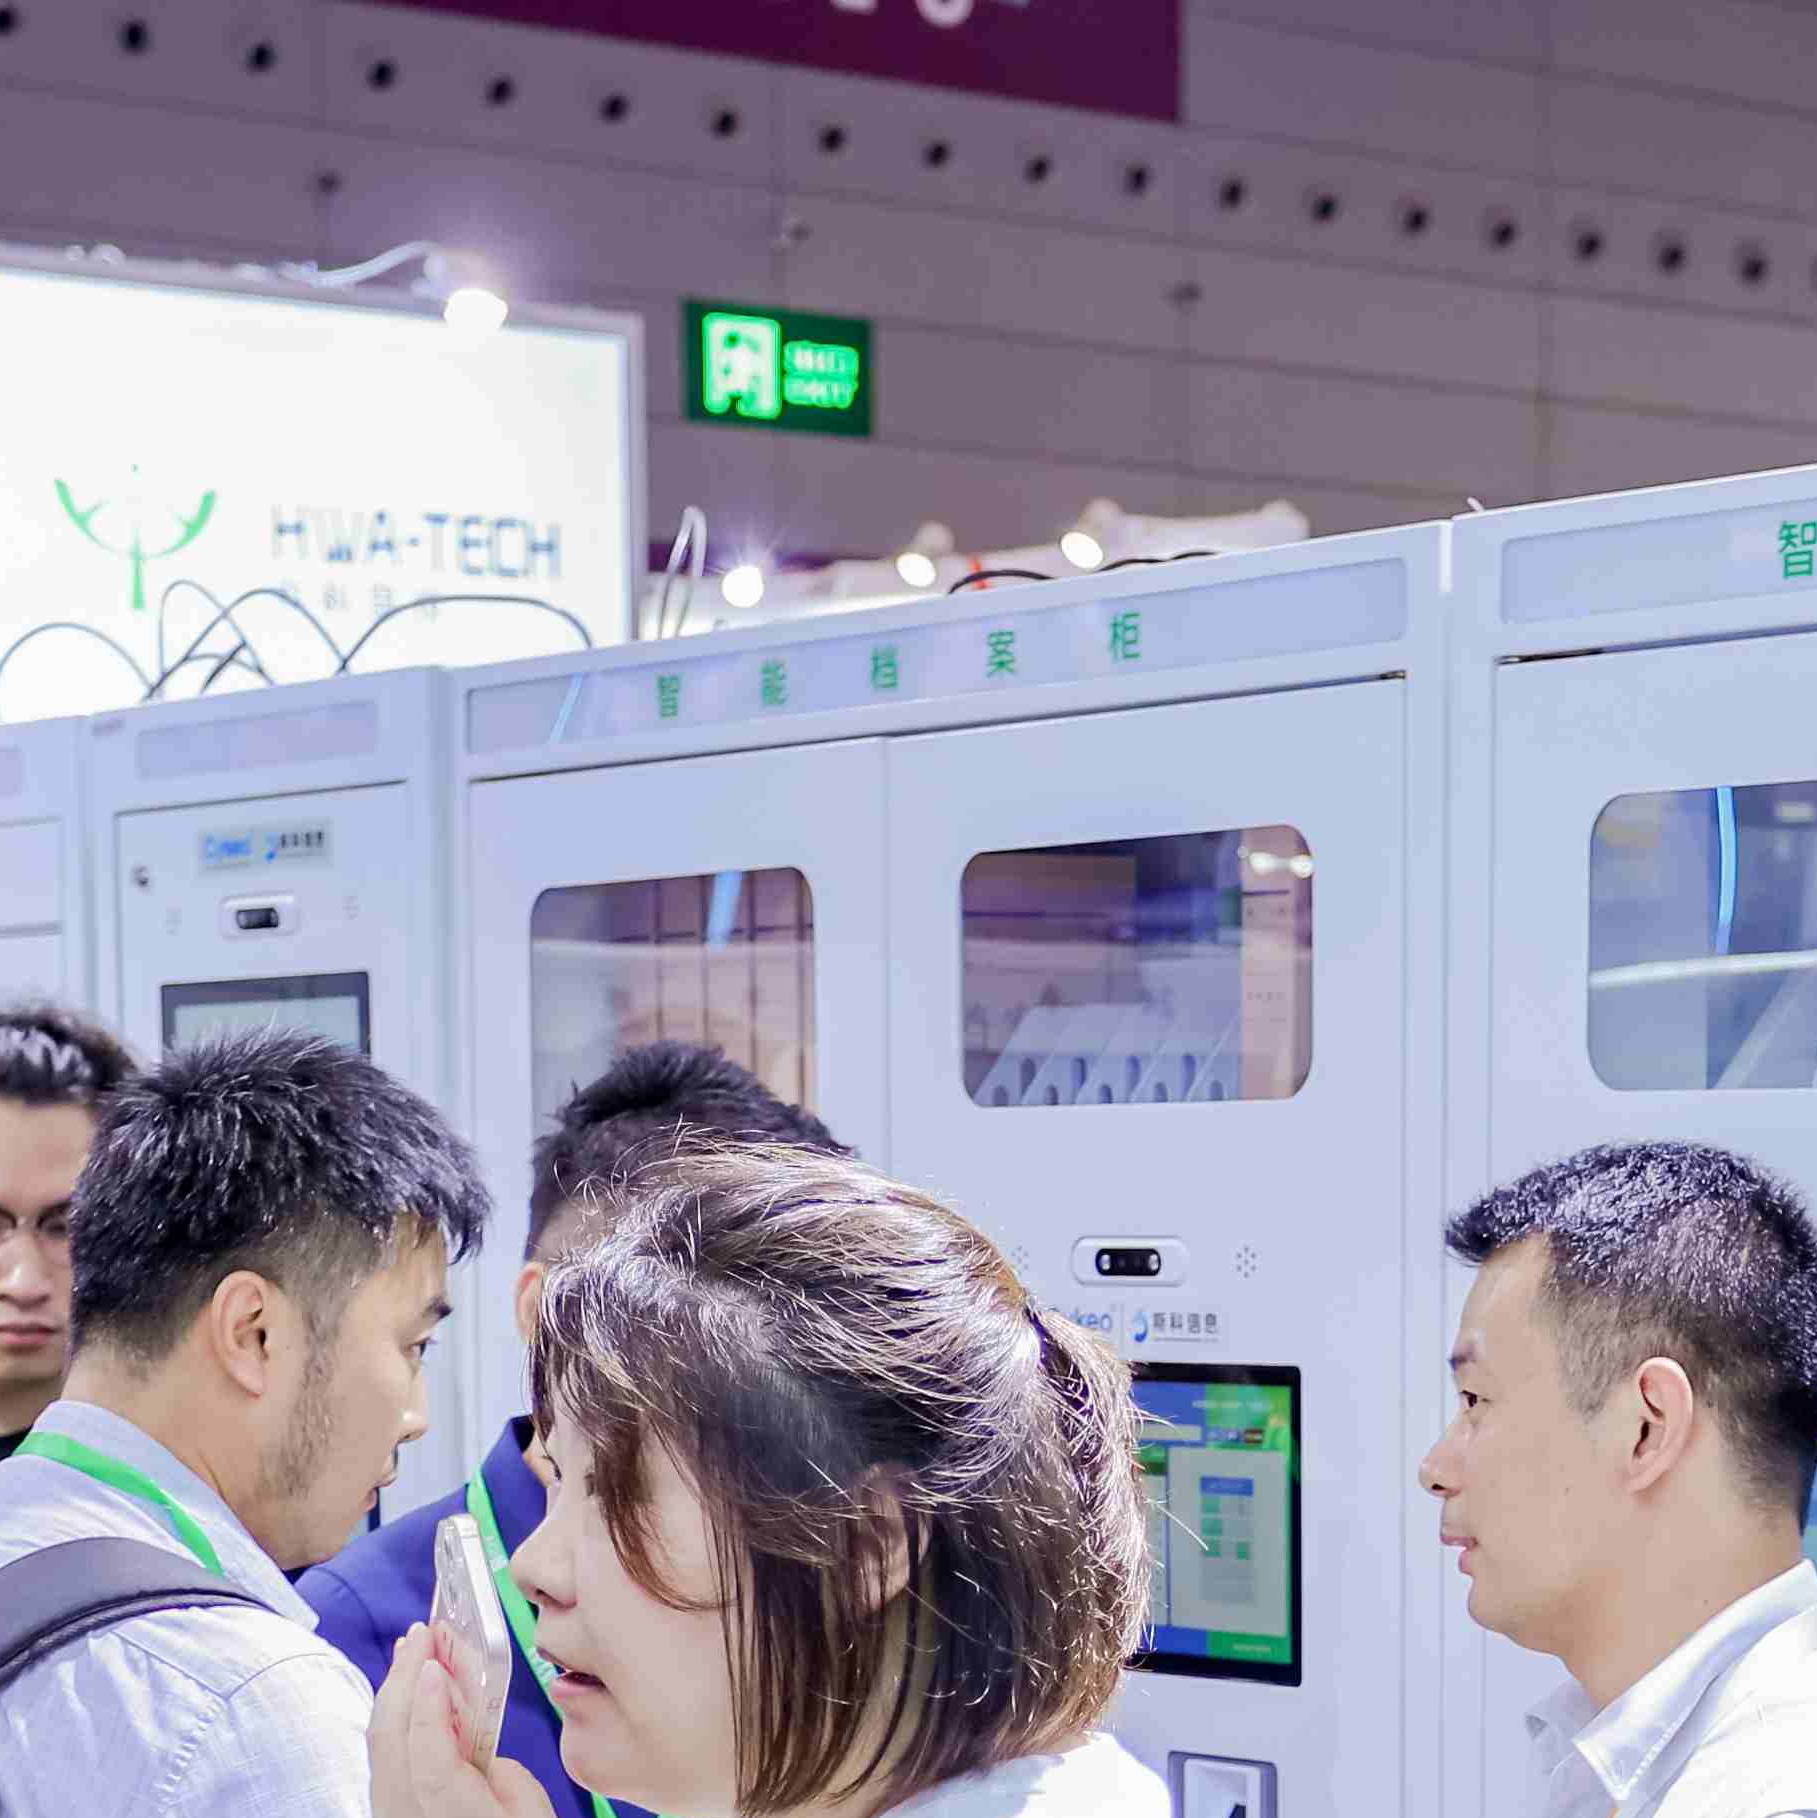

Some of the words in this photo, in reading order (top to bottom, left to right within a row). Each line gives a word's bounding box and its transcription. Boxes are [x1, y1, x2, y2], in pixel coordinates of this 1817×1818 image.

[656, 611, 1143, 719] 智能档案柜
